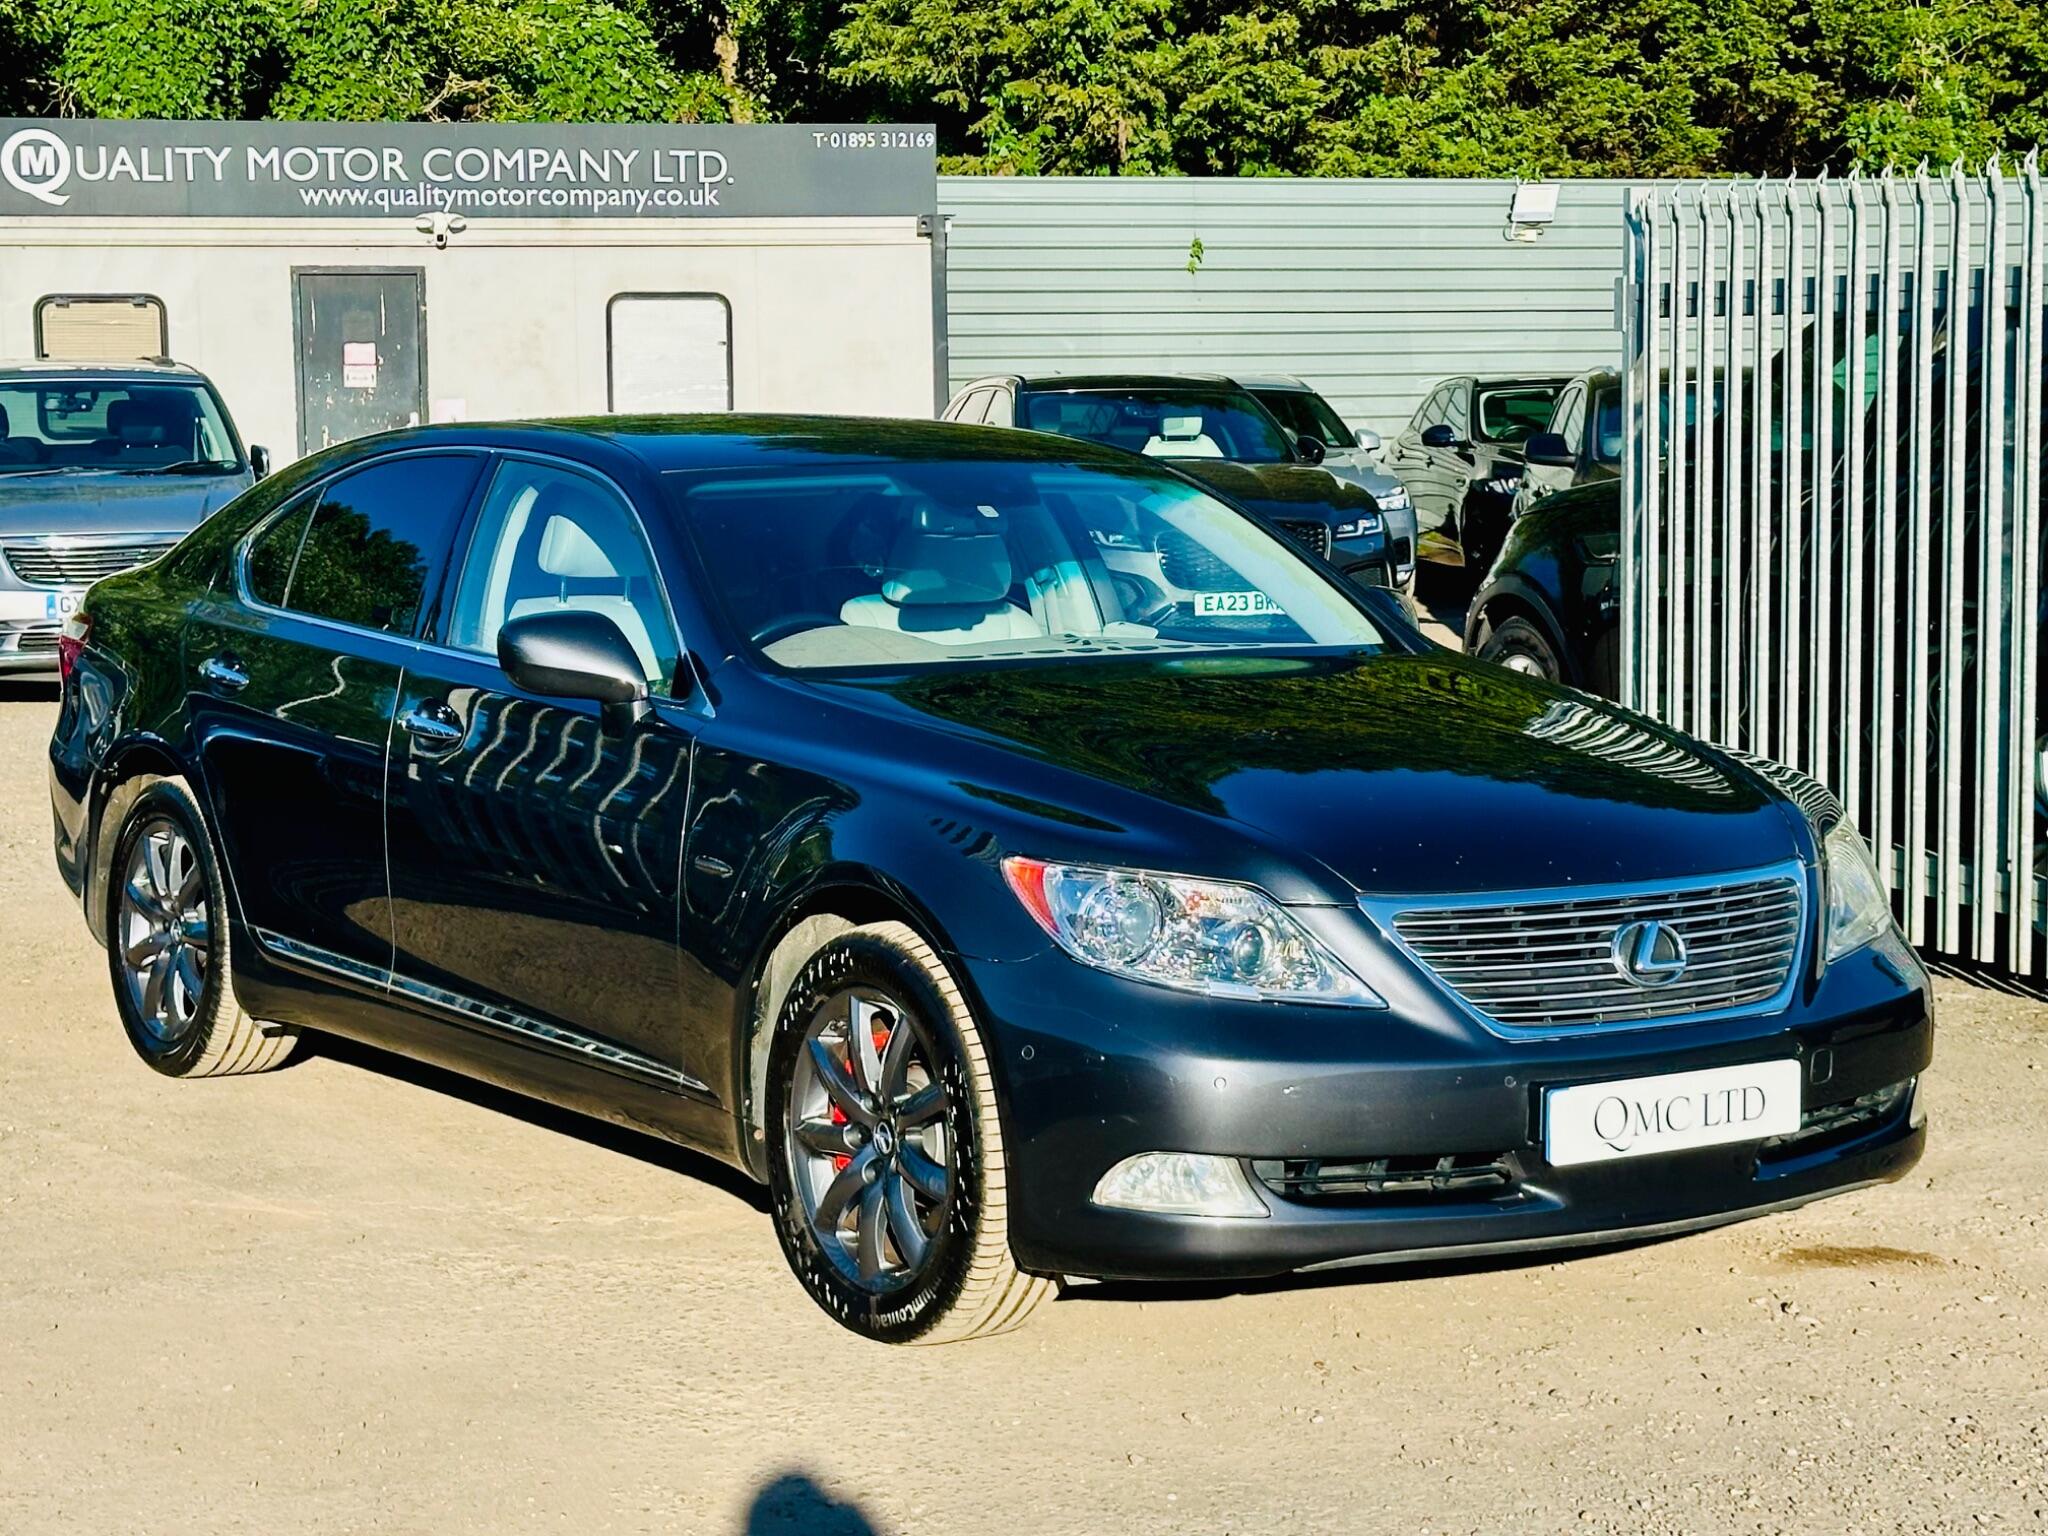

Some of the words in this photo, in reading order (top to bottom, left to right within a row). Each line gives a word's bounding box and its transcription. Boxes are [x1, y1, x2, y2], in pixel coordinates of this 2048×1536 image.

[881, 132, 935, 148] 312169
[247, 146, 408, 182] MOTOR
[422, 148, 640, 183] COMPANY
[653, 149, 735, 185] LTD.
[299, 182, 720, 213] www.qualitymotorcompany.co.uk
[1203, 595, 1249, 611] EA23
[1594, 1096, 1690, 1152] QMC
[1703, 1085, 1766, 1127] LTD
